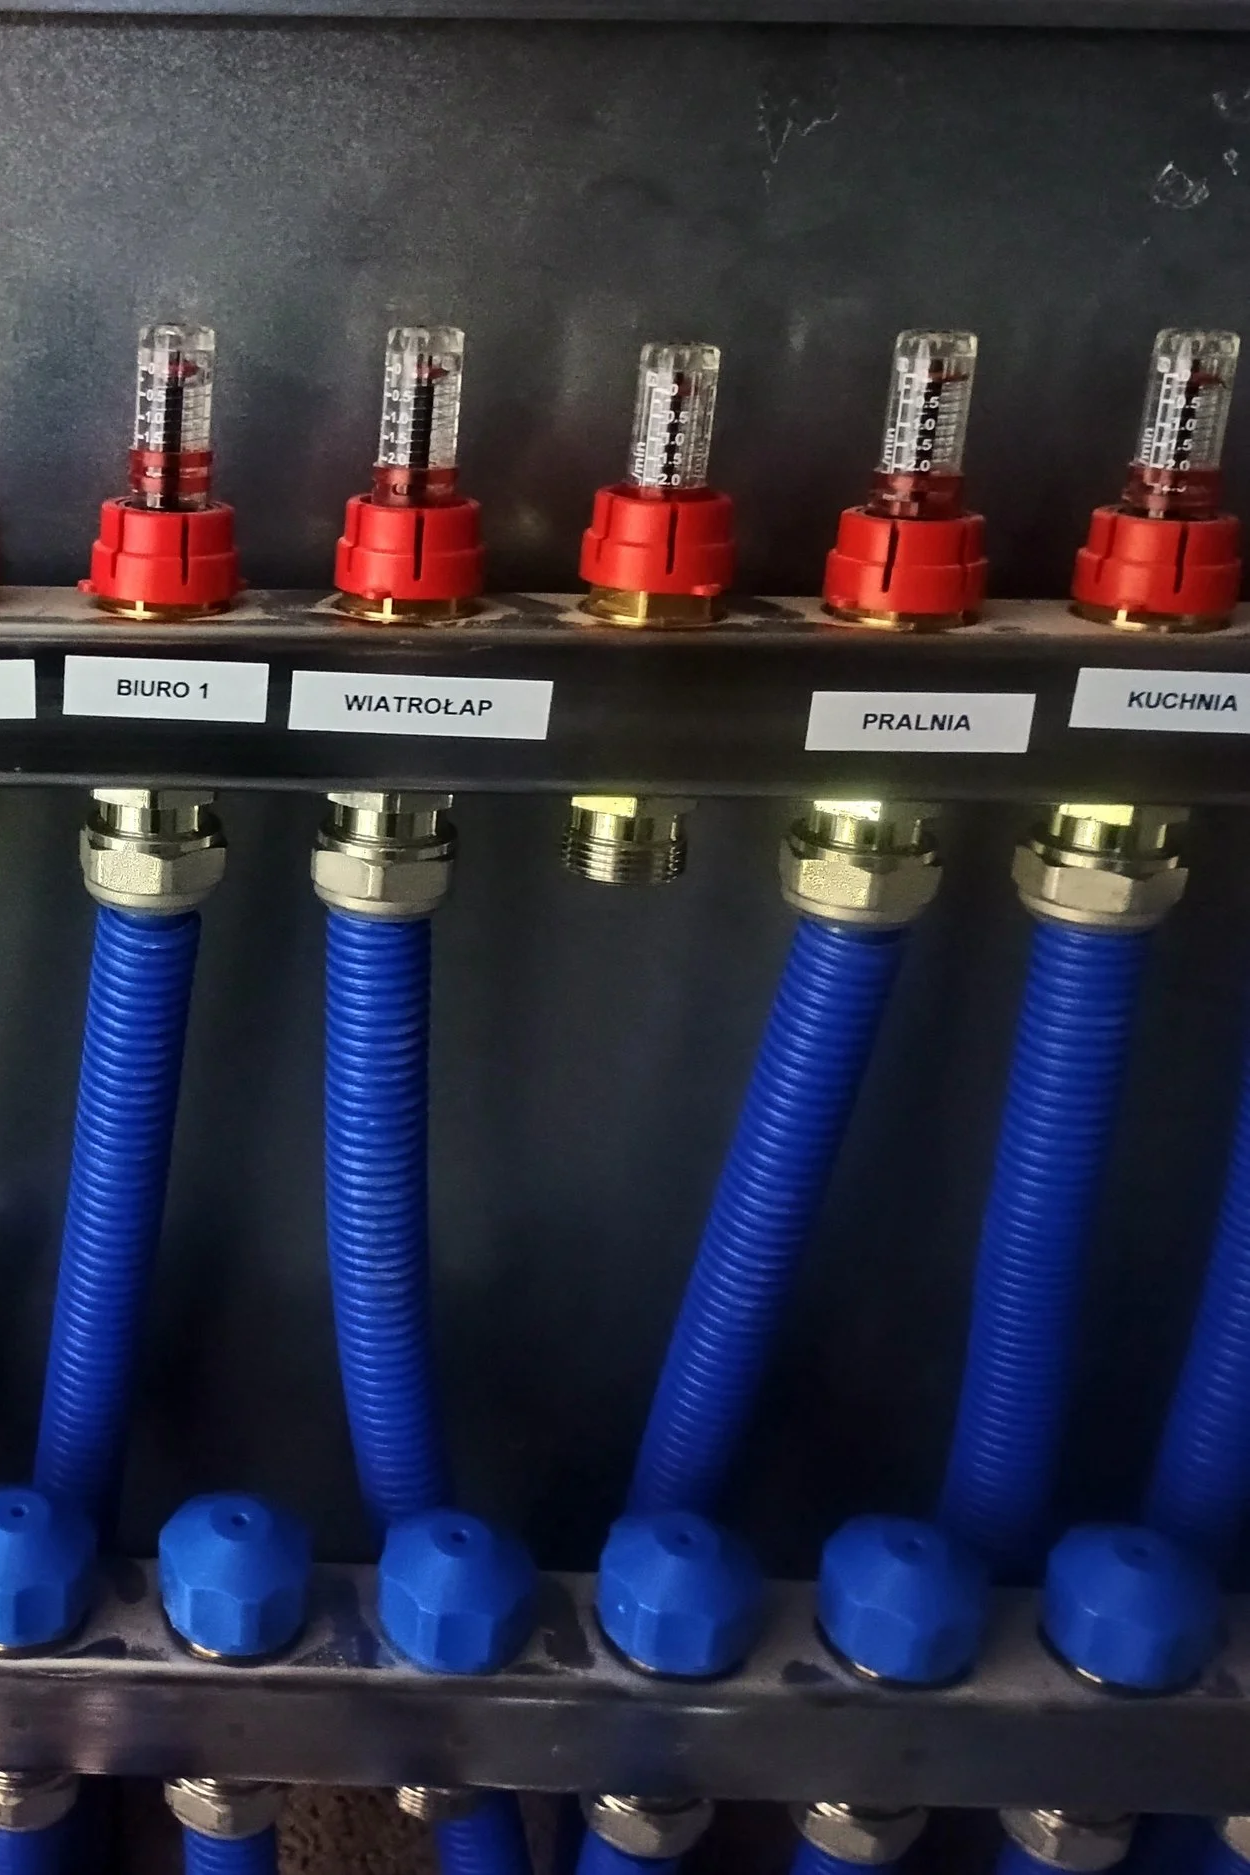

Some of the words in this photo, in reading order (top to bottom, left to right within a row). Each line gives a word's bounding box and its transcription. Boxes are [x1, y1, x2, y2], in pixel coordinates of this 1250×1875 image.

[906, 459, 931, 472] 2.0
[657, 473, 681, 486] 2.0
[116, 678, 190, 698] BIURO
[199, 682, 209, 699] 1
[344, 694, 493, 717] WIATROŁAP
[1127, 690, 1238, 712] KUCHNIA
[862, 713, 971, 731] PRALNIA
